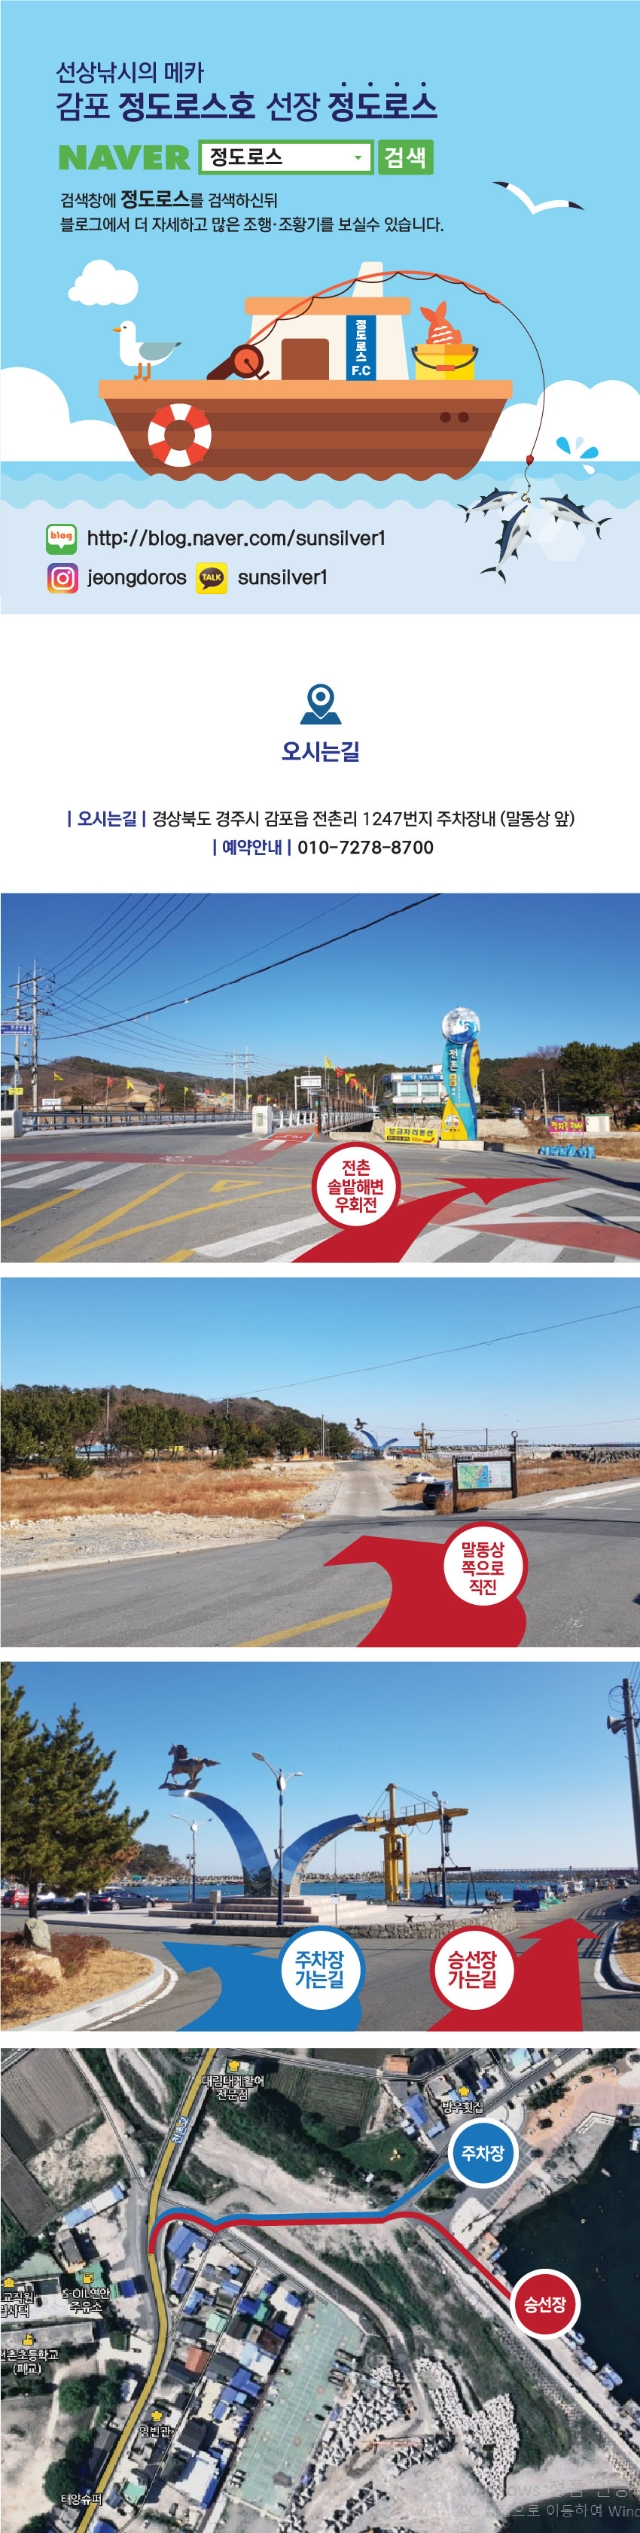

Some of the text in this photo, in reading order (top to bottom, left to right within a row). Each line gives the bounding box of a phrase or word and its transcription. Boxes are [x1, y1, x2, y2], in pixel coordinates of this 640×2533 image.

[56, 61, 204, 84] 선상낚시의 메카
[56, 91, 438, 122] 감포 정도로스호 선장 정도로스
[59, 145, 191, 170] NAVER
[210, 147, 283, 167] 정도로스
[385, 147, 425, 169] 검색
[61, 190, 277, 209] 검색창에 정도로스를 검색하신뒤
[60, 216, 444, 233] 블로그에서 더 자세하고 많은 조행·조황기를 보실수 있습니다.
[356, 320, 367, 362] 정도로스
[351, 365, 371, 376] F.C
[50, 531, 73, 542] blog
[88, 529, 384, 549] http://blog.naver.com/sunsilver1
[87, 569, 187, 588] jeongdoros
[238, 569, 326, 585] sunsilver1
[282, 741, 359, 762] 오시는길
[77, 810, 575, 828] 오시는길 경상북도 경주시 감포읍 전촌리 1247번지 주차장내 (말동상 앞)
[223, 839, 434, 856] 예약안내 010-7278-8700
